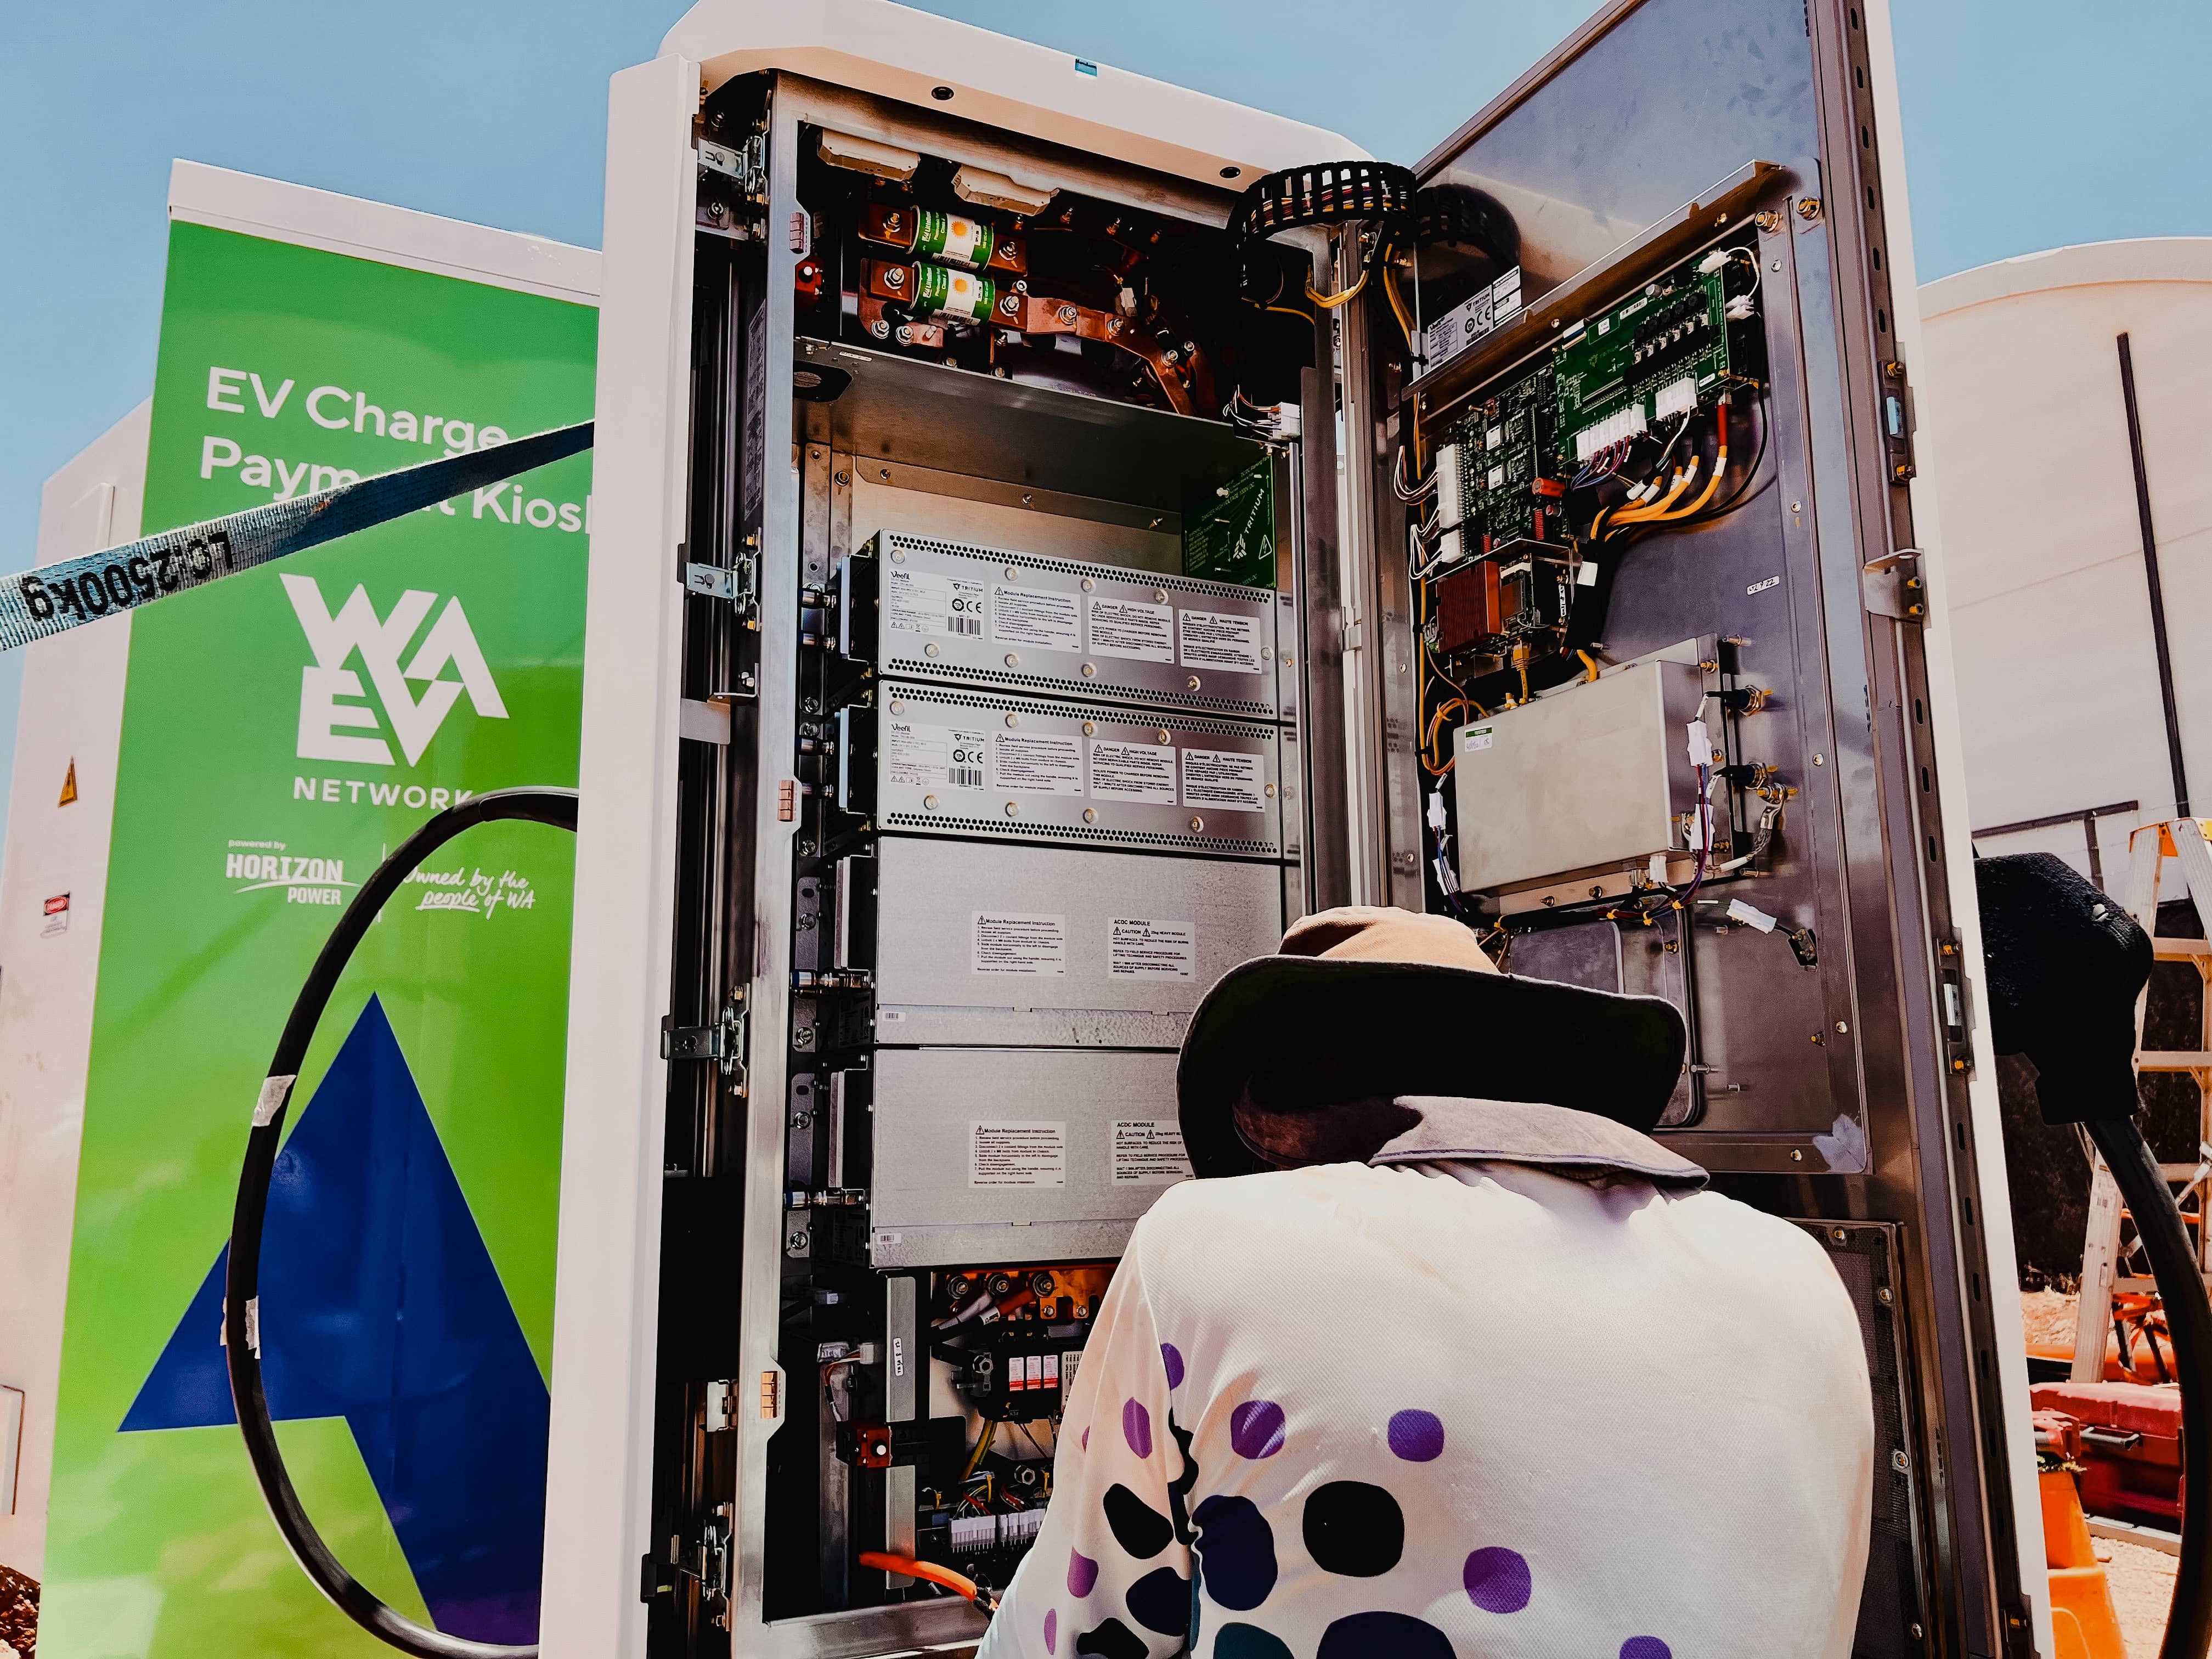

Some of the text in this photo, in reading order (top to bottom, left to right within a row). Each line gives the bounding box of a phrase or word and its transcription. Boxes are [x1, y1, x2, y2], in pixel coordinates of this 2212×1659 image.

[206, 366, 510, 459] EV Charge
[473, 482, 591, 533] Kios
[1244, 489, 1265, 534] TRITIUM
[294, 776, 473, 811] NETWORK
[228, 839, 286, 851] powered by
[225, 853, 343, 883] HORIZON
[470, 868, 495, 896] by
[499, 870, 529, 889] the
[287, 886, 342, 906] POWER
[422, 888, 536, 920] people of WA
